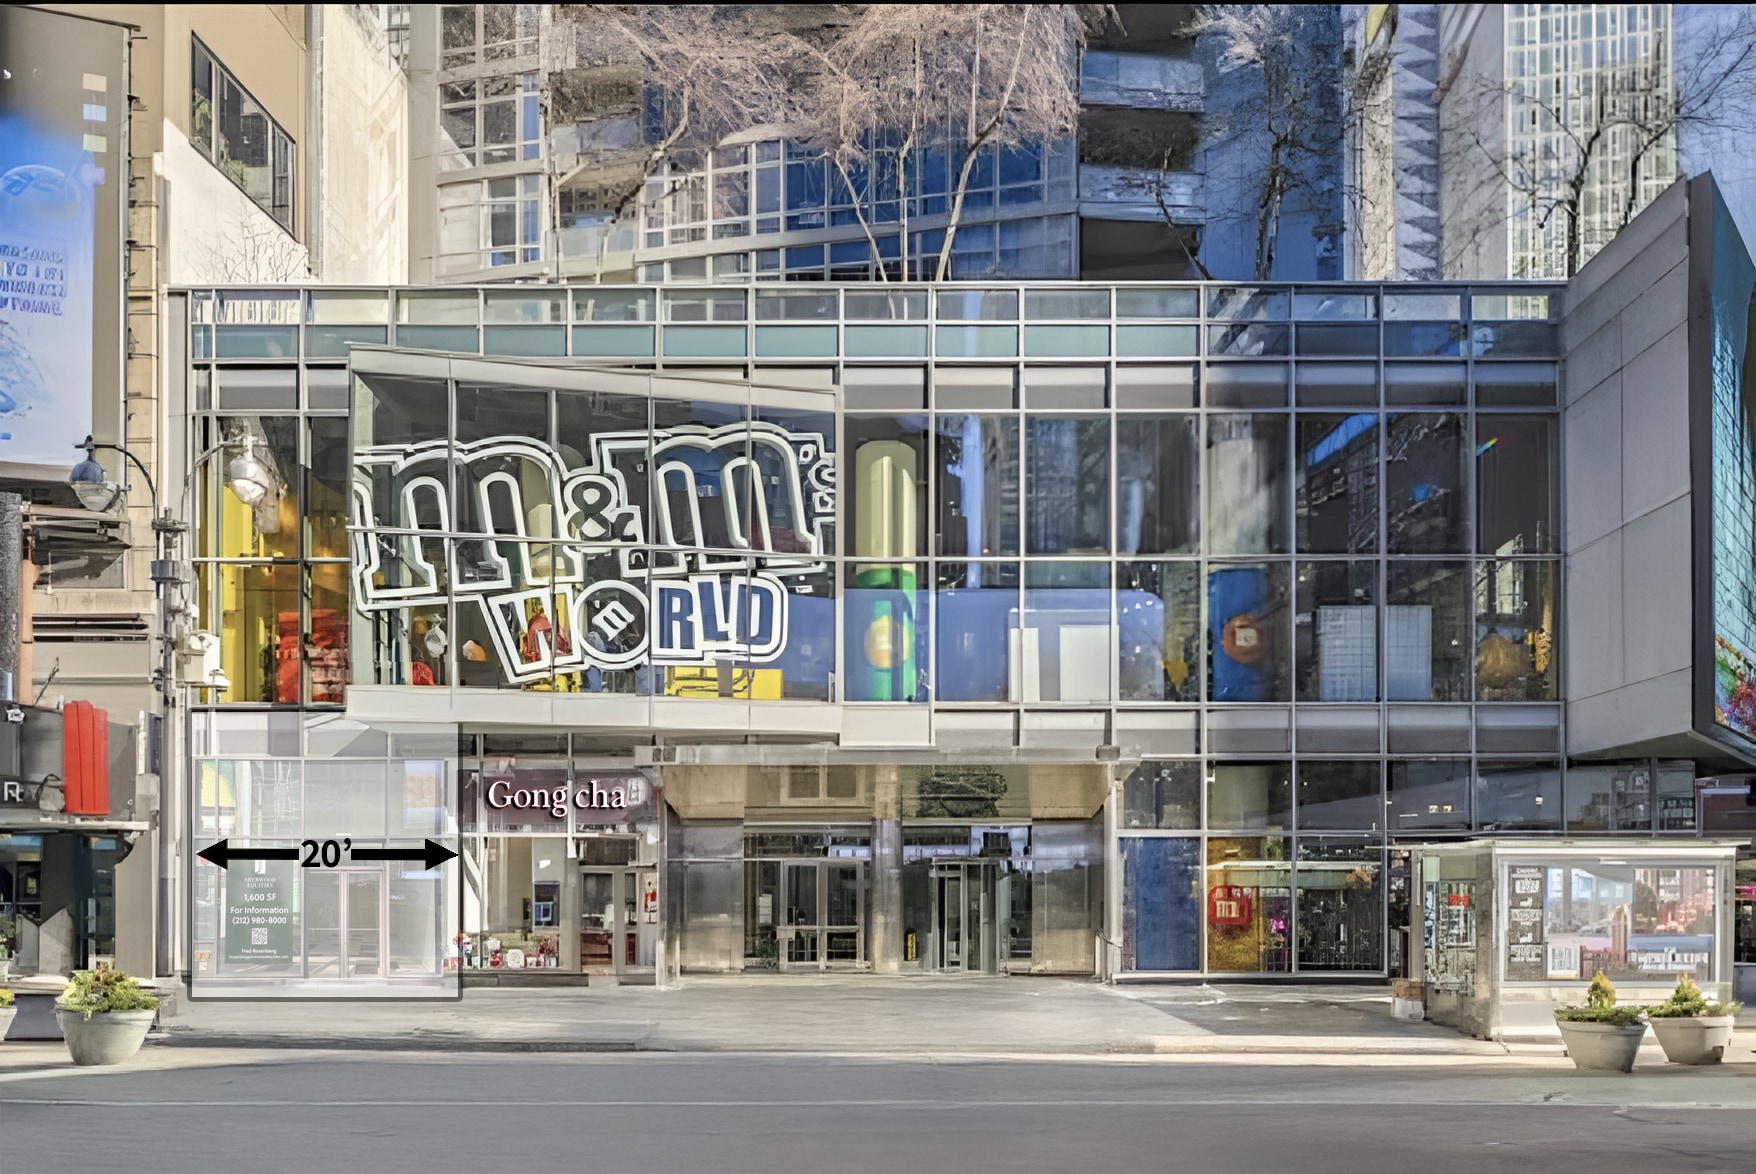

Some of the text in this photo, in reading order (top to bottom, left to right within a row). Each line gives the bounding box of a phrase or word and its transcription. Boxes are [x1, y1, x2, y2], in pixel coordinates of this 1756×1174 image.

[488, 779, 627, 818] Gong cha
[244, 893, 277, 902] 1,600 SF
[230, 906, 289, 914] For Information
[232, 916, 287, 925] (212) 980-8000
